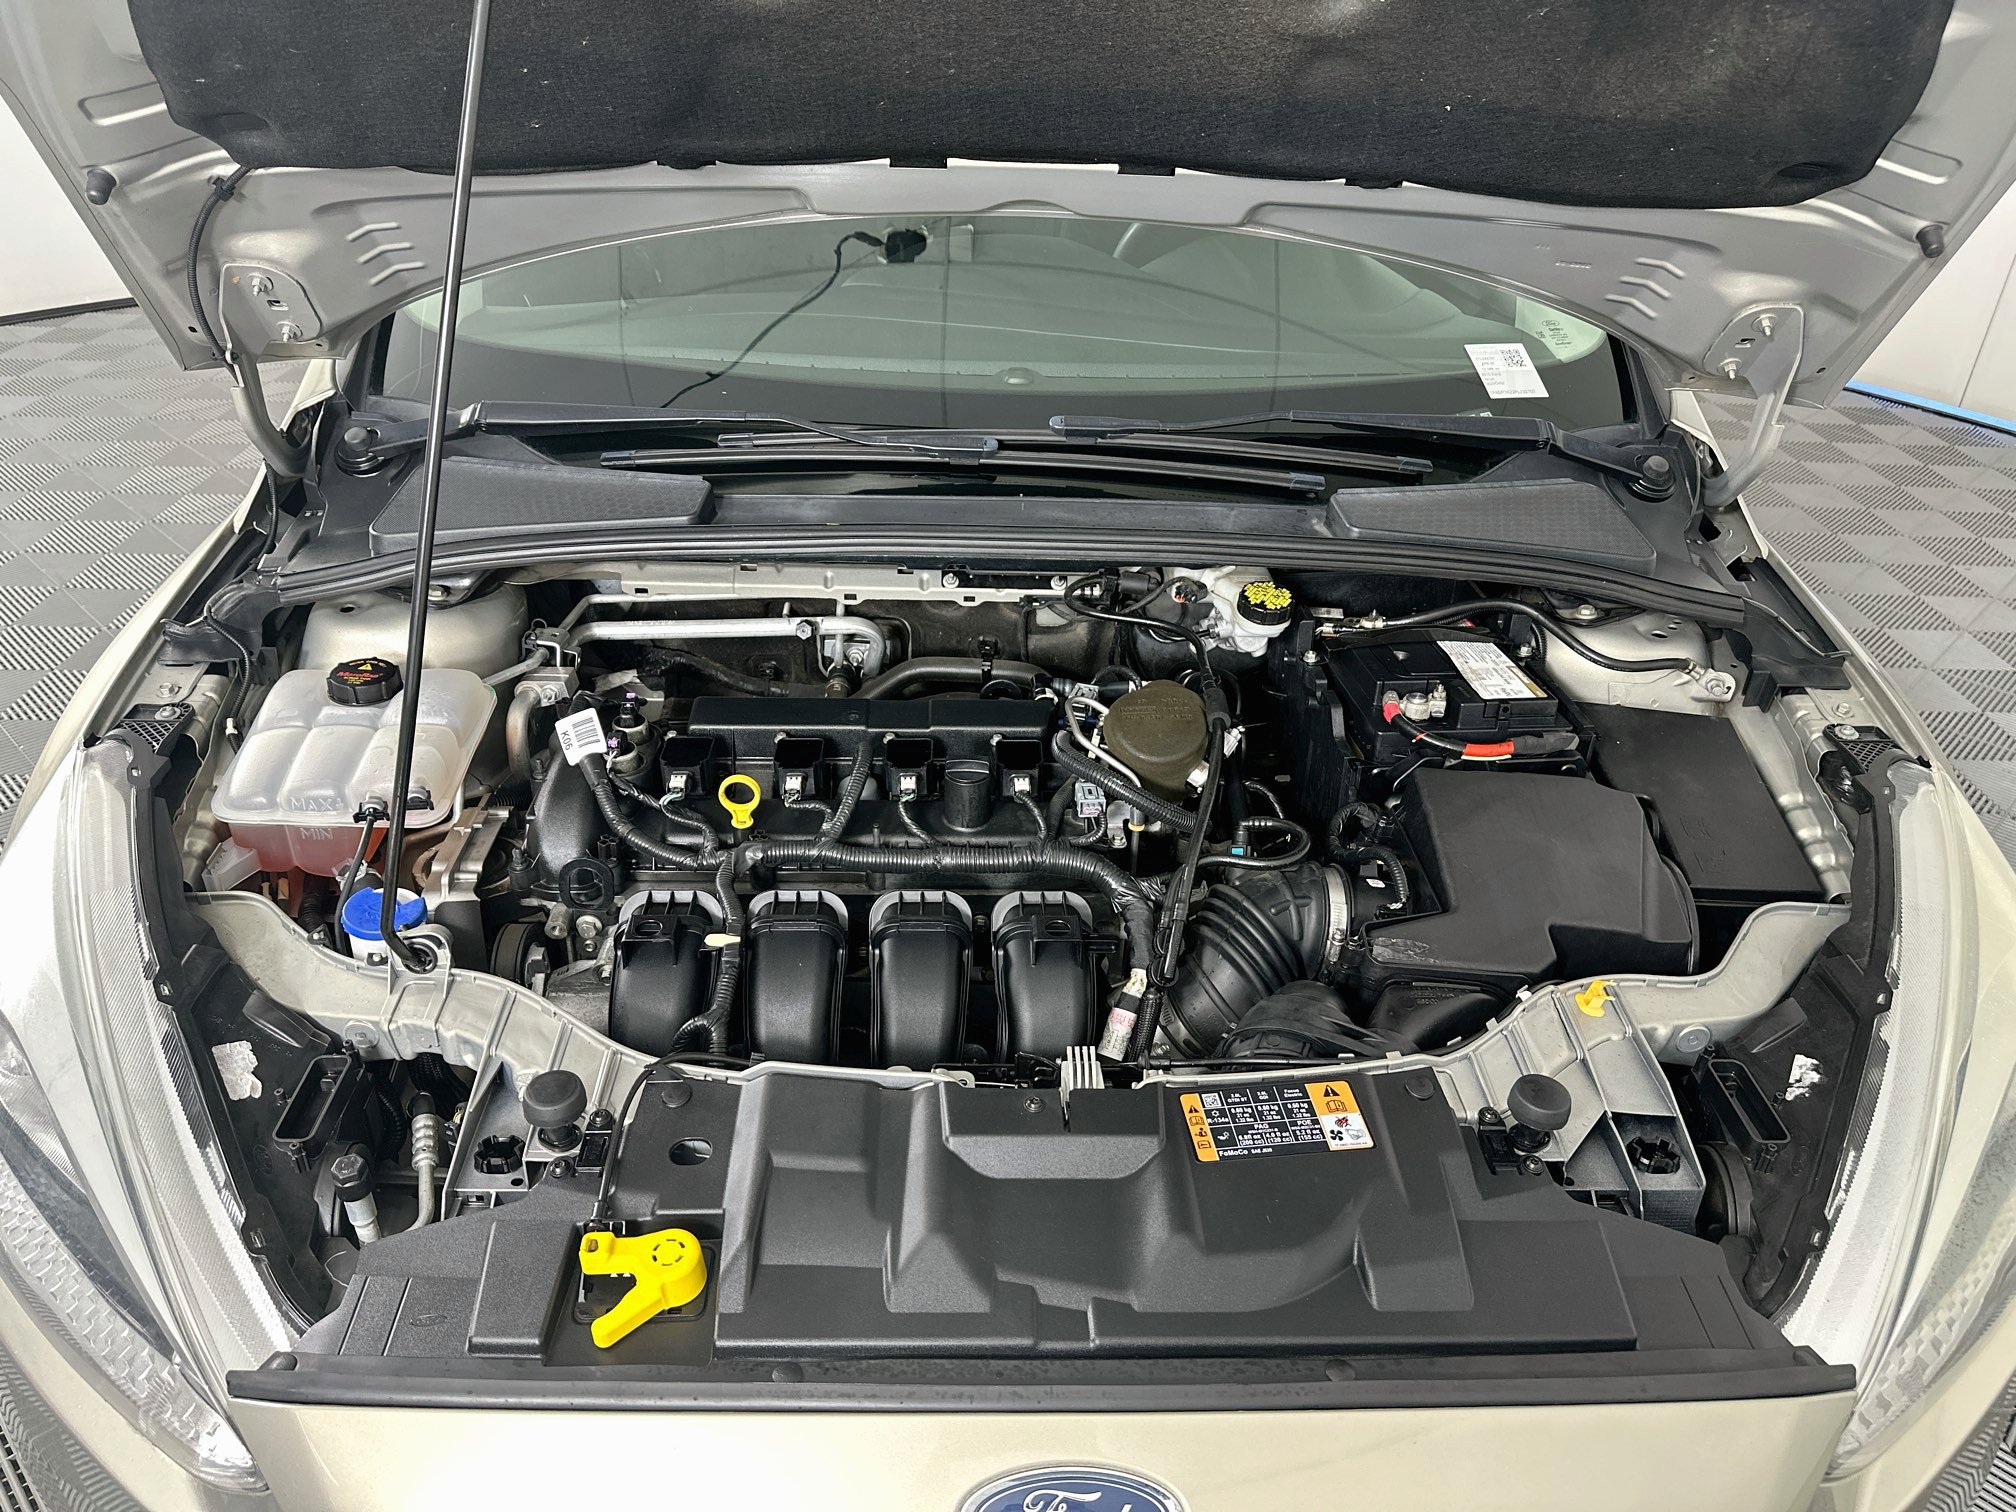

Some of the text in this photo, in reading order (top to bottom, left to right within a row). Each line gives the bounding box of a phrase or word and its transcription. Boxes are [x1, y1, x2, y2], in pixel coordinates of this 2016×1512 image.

[560, 730, 574, 751] K06
[290, 796, 333, 811] MAX
[299, 827, 334, 840] MIN
[1218, 1148, 1248, 1157] FoMoCo
